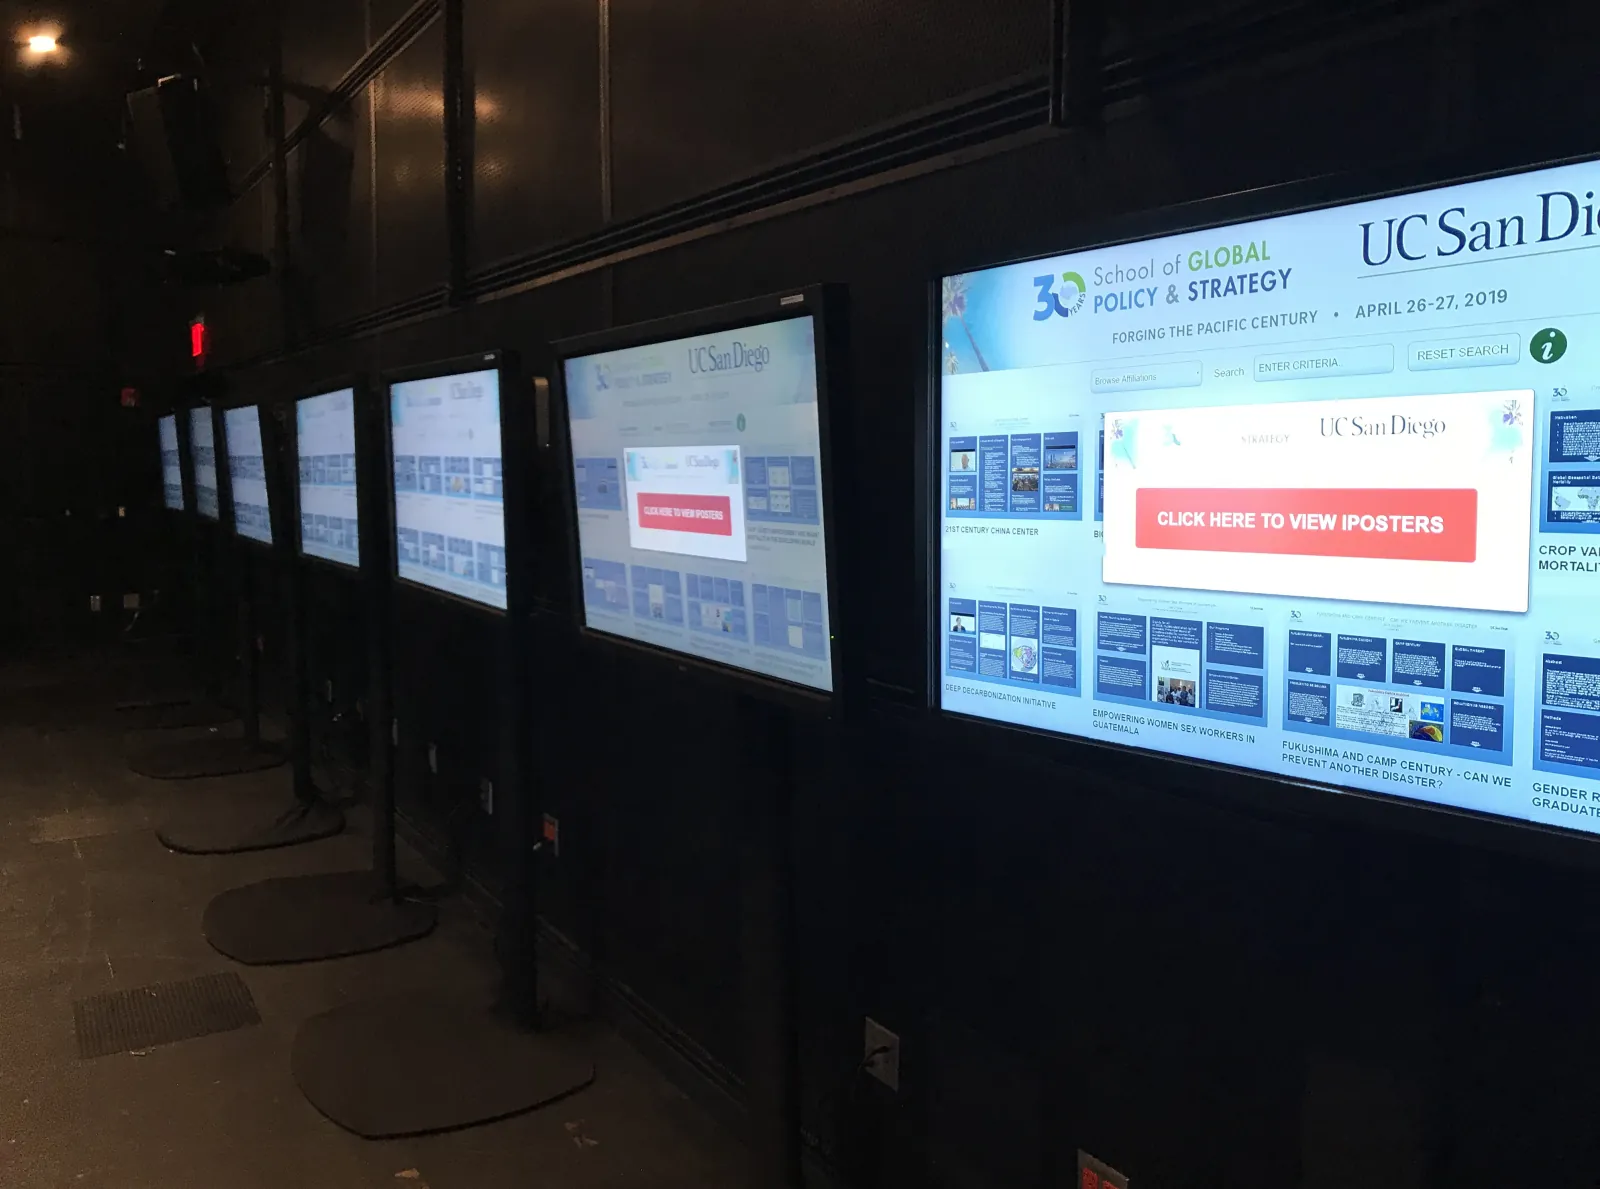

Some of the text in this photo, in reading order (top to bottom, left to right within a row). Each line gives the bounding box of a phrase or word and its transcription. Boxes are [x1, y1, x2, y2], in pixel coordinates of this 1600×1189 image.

[1359, 190, 1600, 267] UC San Di
[1094, 240, 1271, 287] School of GLOBAL
[1094, 267, 1293, 314] POLICY & STRATEGY
[1069, 293, 1086, 316] YEARS
[1355, 288, 1509, 319] APRIL 26-27, 2019
[1112, 309, 1318, 345] FORGING THE PACIFIC CENTURY
[688, 341, 770, 374] UC San Diego
[1417, 343, 1510, 361] RESET SEARCH
[1213, 366, 1245, 378] Search
[1258, 361, 1291, 373] ENTER
[1094, 373, 1157, 386] Browse Affiliations
[1320, 414, 1446, 439] UC San Diego
[644, 506, 661, 516] CLICK
[661, 507, 674, 517] HERE
[674, 508, 681, 518] TO
[681, 508, 695, 518] VIEW
[1156, 510, 1445, 534] CLICK HERE TO VIEW IPOSTERS
[945, 525, 1039, 537] 21ST CENTURY CHINA CENTER
[1539, 544, 1600, 557] CROP VA
[945, 683, 1057, 710] DEEP DECARBONIZATION INITIATIVE
[1092, 708, 1255, 744] EMPOWERING WOMEN SEX WORKERS IN
[1092, 720, 1140, 736] GUATEMALA
[1282, 740, 1340, 759] FUKUSHIMA
[1342, 751, 1364, 763] AND
[1366, 755, 1398, 769] CAMP
[1400, 760, 1454, 778] CENTURY
[1463, 770, 1490, 783] CAN
[1492, 775, 1512, 788] WE
[1282, 753, 1443, 789] PREVENT ANOTHER DISASTER?
[1532, 782, 1588, 801] GENDER
